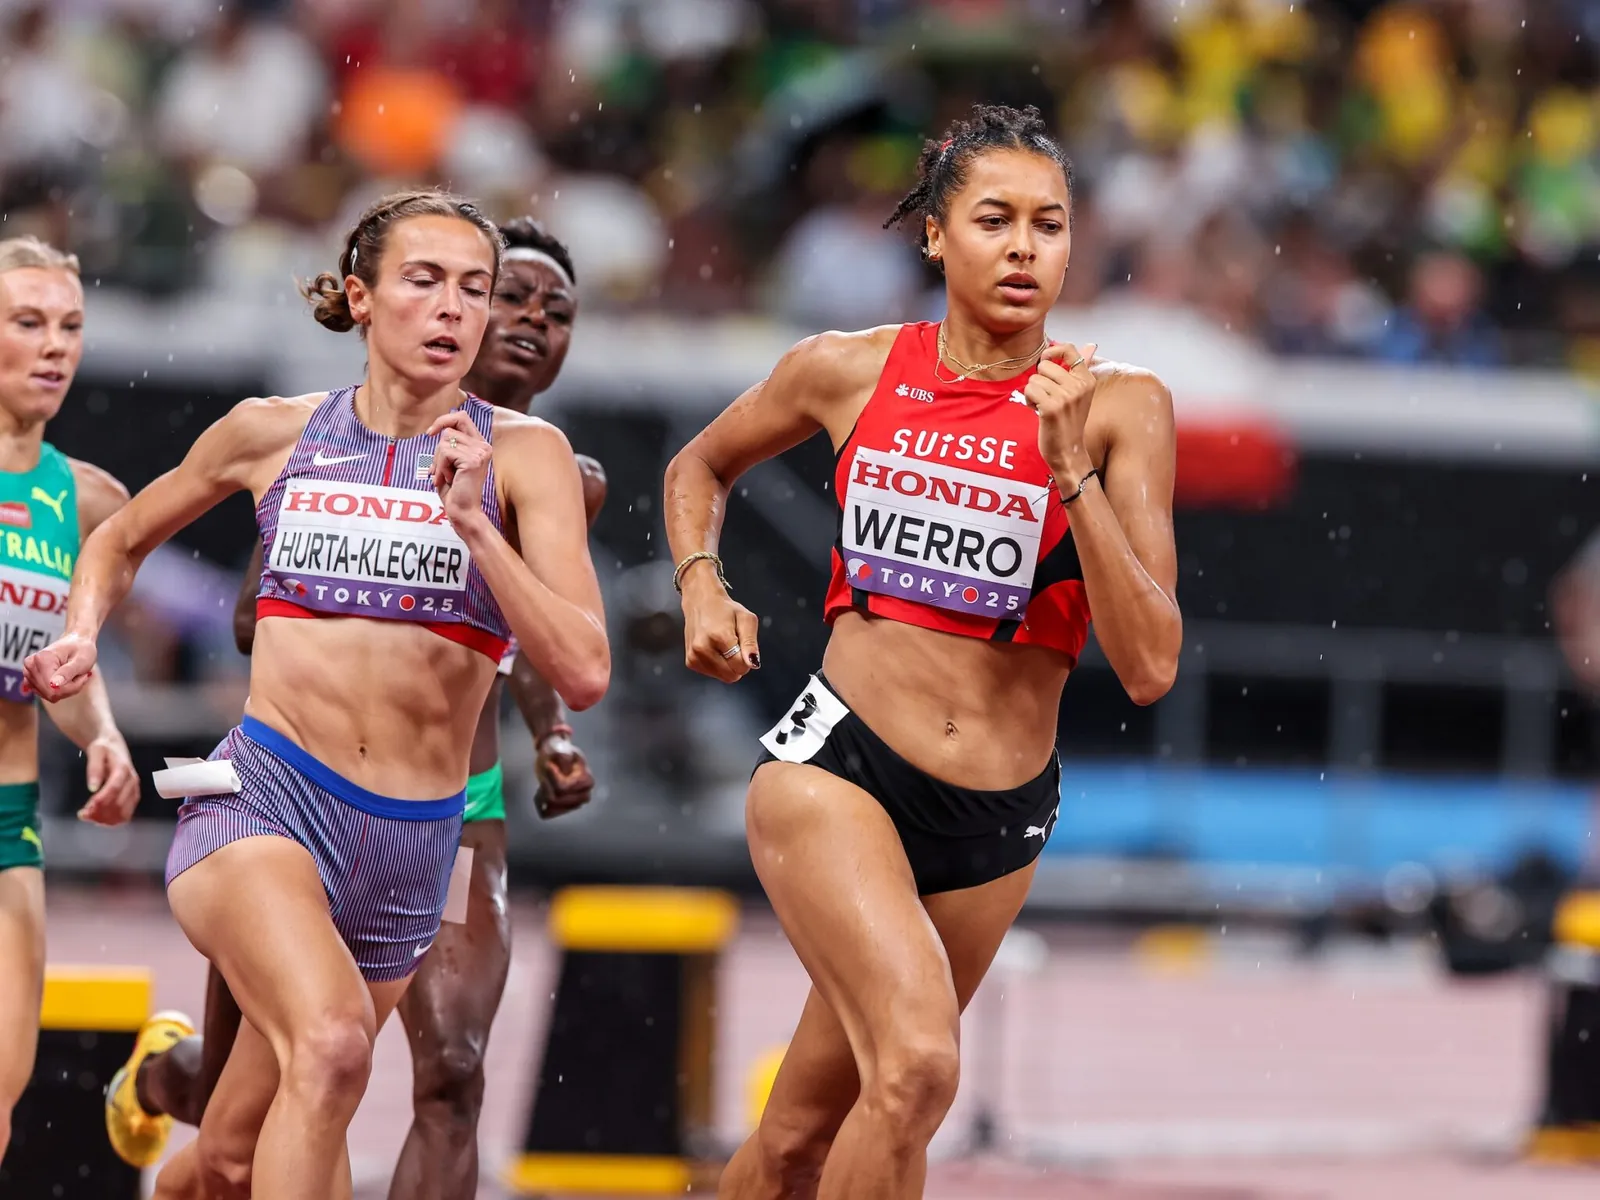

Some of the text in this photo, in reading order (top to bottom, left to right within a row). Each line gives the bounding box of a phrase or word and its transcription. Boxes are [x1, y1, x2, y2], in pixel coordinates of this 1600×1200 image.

[909, 387, 935, 403] UBS
[852, 459, 1039, 523] HONDA
[276, 531, 462, 585] HURTA-KLECKER
[854, 504, 1023, 578] WERRO
[315, 584, 454, 613] TOKYO 25
[880, 567, 1020, 611] TOKYO 25
